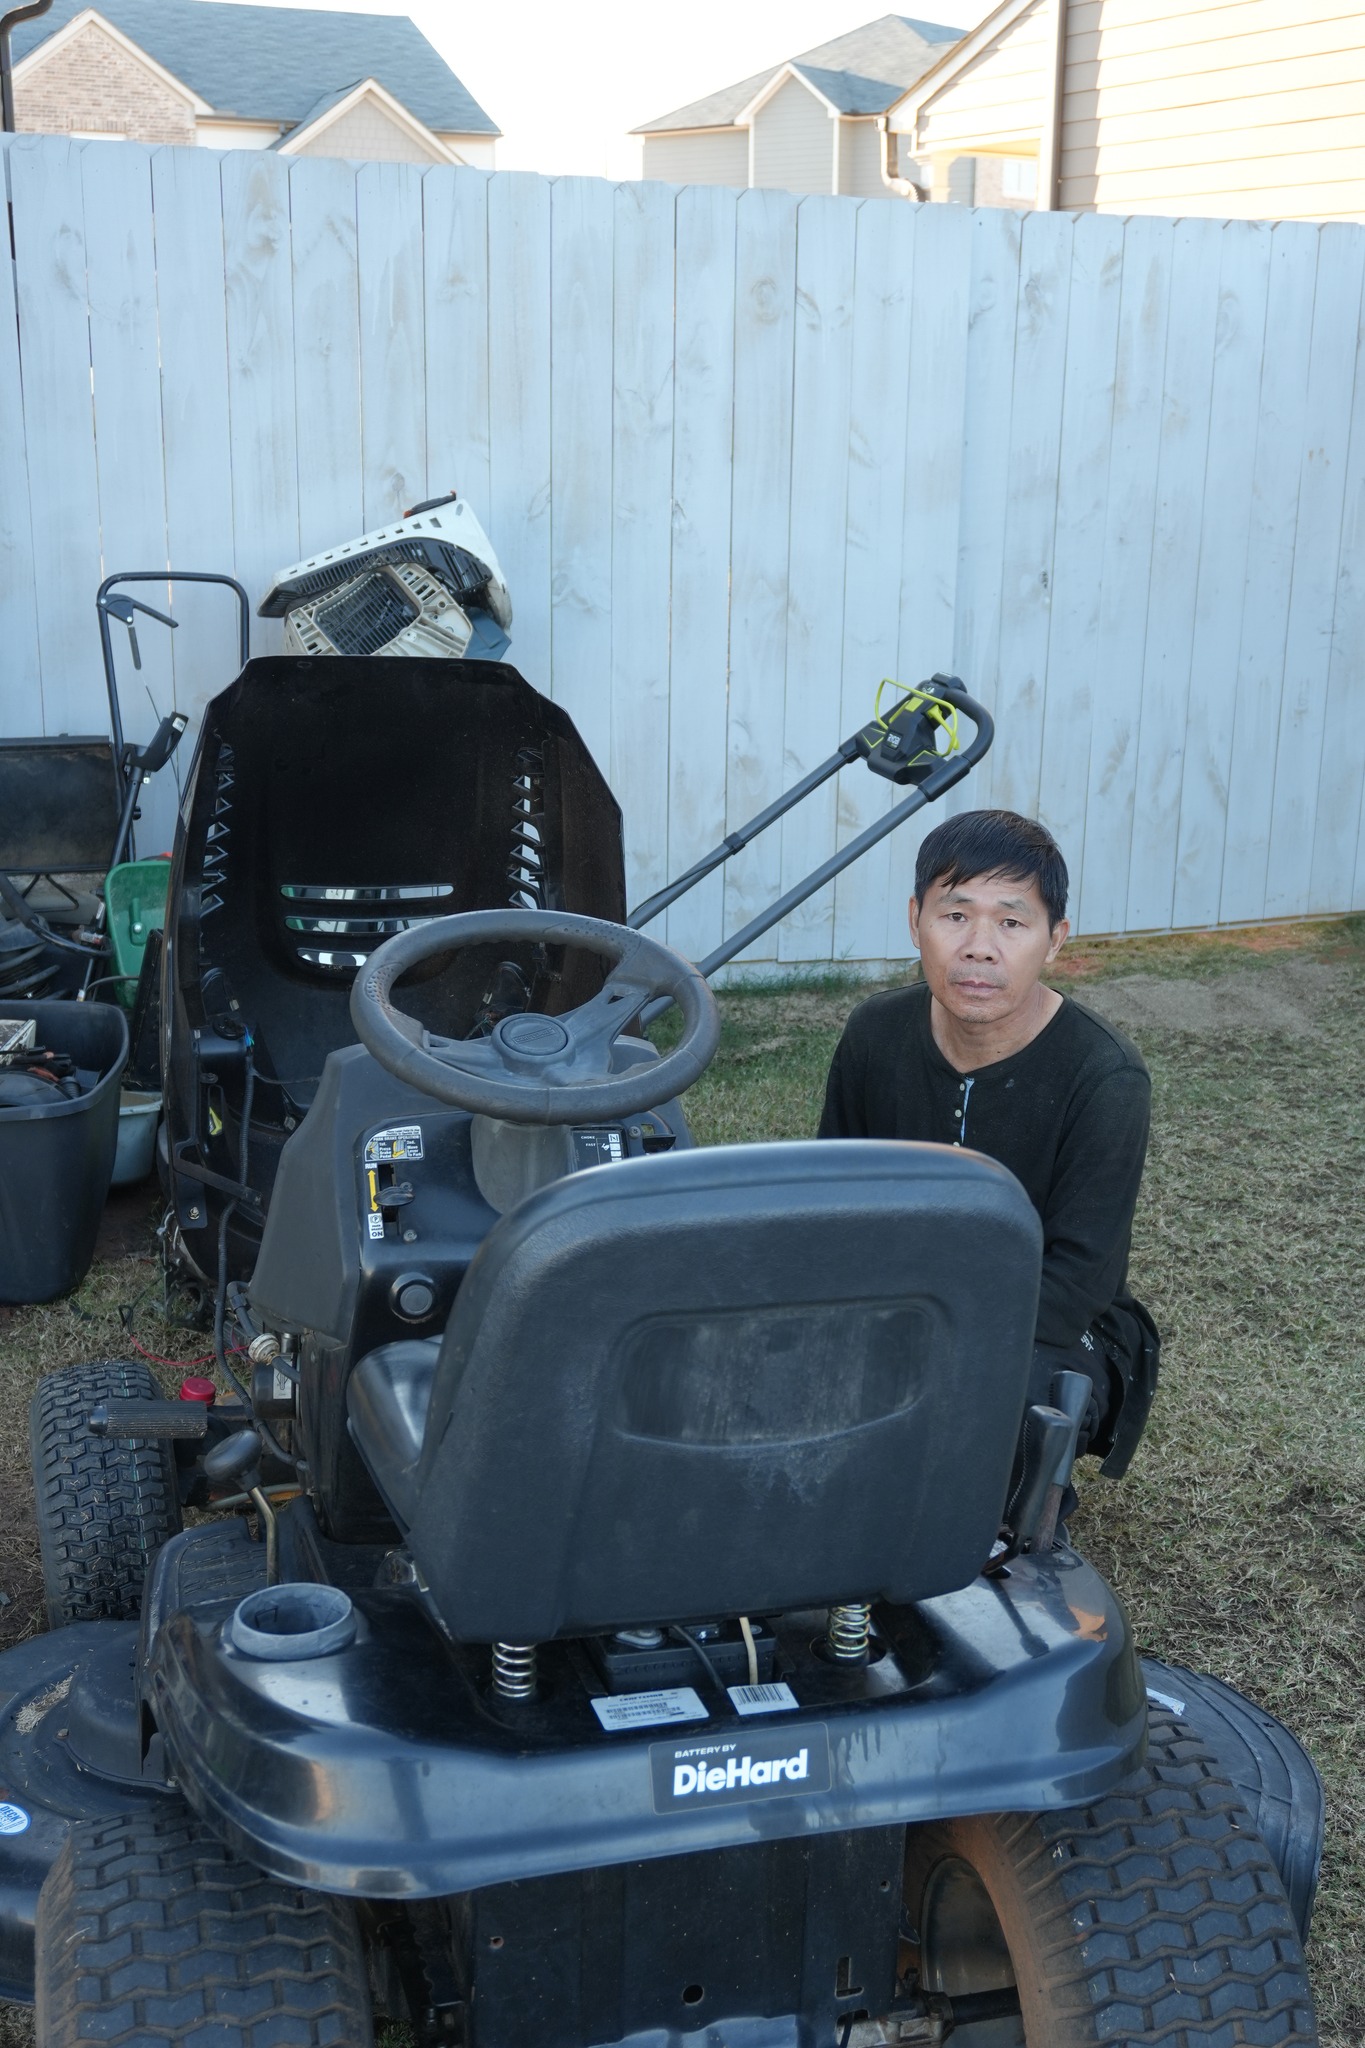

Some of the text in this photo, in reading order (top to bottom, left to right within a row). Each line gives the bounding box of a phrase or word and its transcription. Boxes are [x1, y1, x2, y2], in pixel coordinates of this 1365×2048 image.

[674, 1743, 737, 1758] BATTERY BY
[673, 1748, 808, 1796] DieHard
